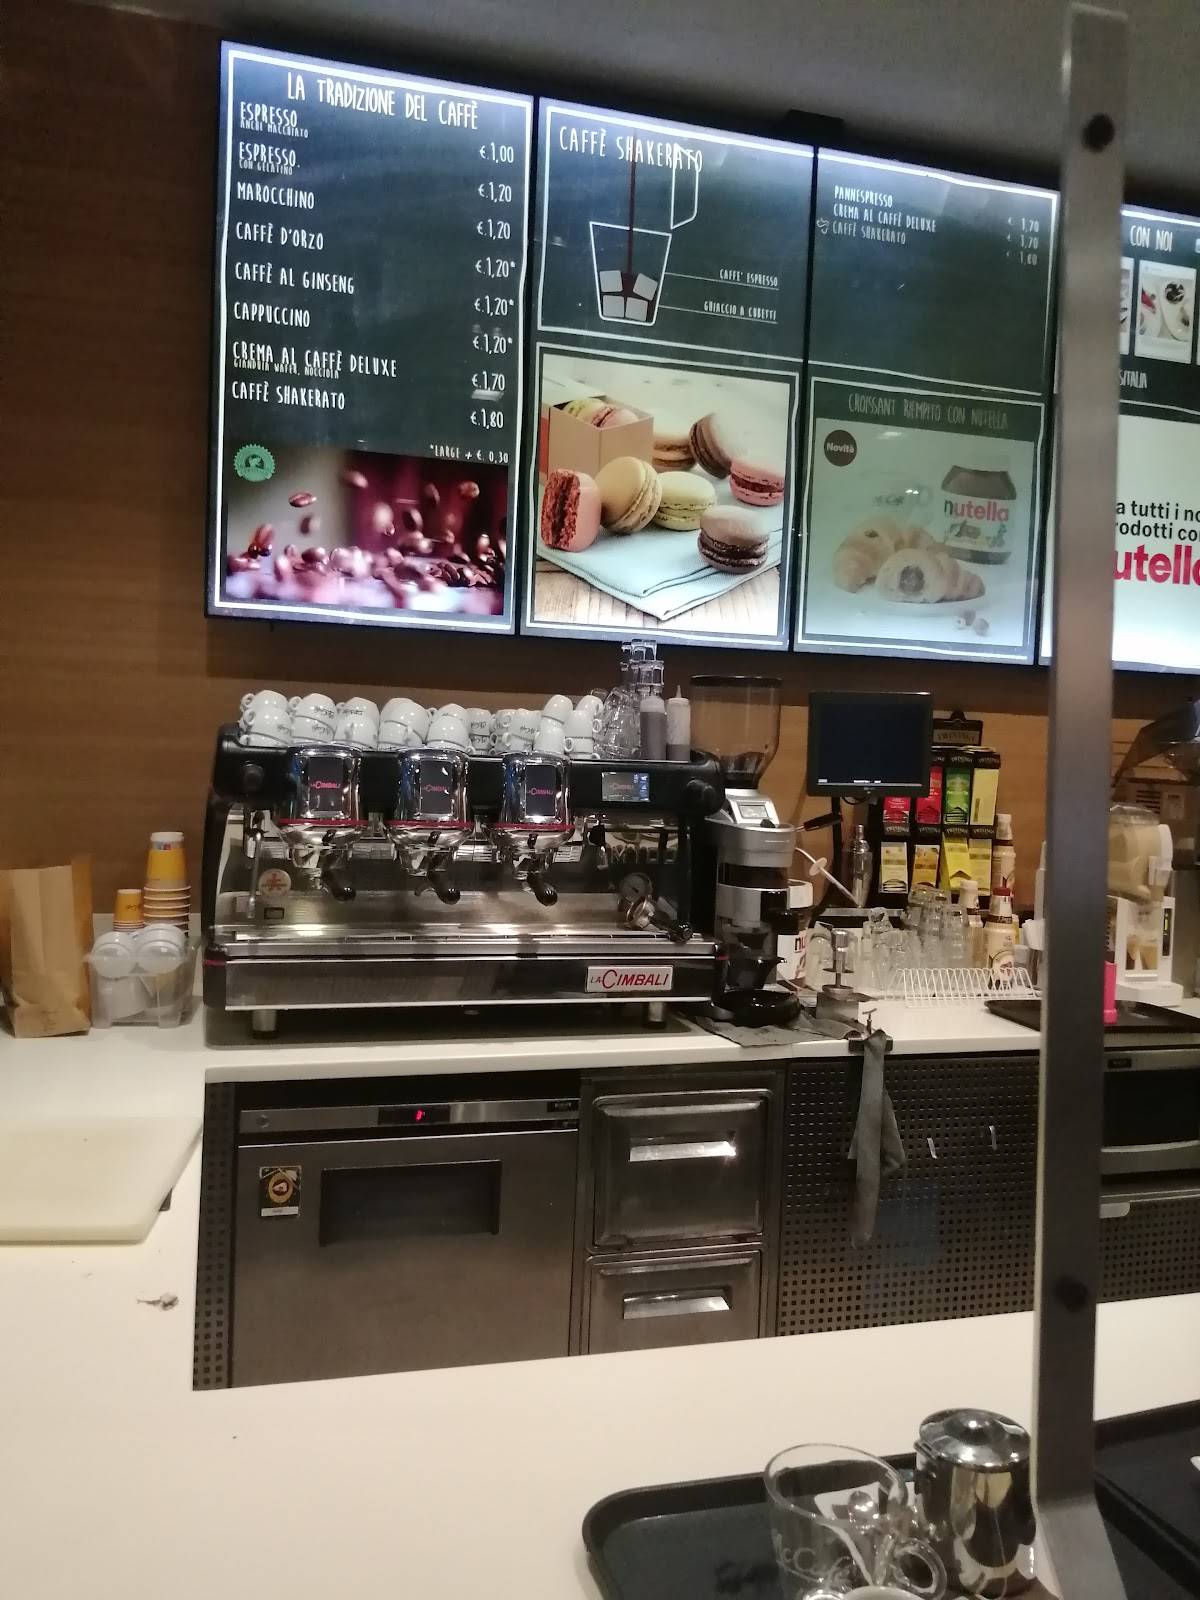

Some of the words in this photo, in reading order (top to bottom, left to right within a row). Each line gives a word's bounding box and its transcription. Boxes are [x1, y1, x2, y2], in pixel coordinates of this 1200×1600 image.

[288, 72, 305, 101] LA
[317, 78, 395, 116] TRADIZIONE
[405, 93, 428, 121] DEL
[439, 101, 478, 130] CAFFÈ
[241, 102, 298, 128] ESPRESSO
[239, 142, 296, 167] ESPRESSO
[559, 126, 607, 157] CAFFÈ
[616, 135, 703, 173] SHAKERATO
[239, 159, 254, 170] CON
[257, 161, 293, 175] GELATINO
[237, 182, 315, 210] MAROCCHINO
[834, 185, 893, 208] PANNESPRESSO
[832, 220, 857, 237] CAFFÈ
[833, 203, 859, 220] CREMA
[863, 208, 873, 223] AL
[878, 211, 902, 227] CAFFÈ
[906, 214, 936, 233] DELUXE
[236, 222, 274, 244] CAFFÈ
[280, 227, 324, 250] D'ORZO
[1130, 225, 1150, 249] CON
[1155, 229, 1173, 253] NOI
[235, 262, 272, 284] CAFFÈ
[280, 267, 295, 287] AL
[302, 271, 355, 295] GINSENG
[746, 272, 778, 287] ESPRESSO
[234, 302, 311, 328] CAPPUCCINO
[739, 305, 745, 316] A
[232, 341, 273, 363] CREMA
[281, 347, 297, 366] AL
[304, 350, 343, 371] CAFFÈ
[350, 354, 397, 378] DELUXE
[232, 381, 269, 403] CAFFÈ
[276, 385, 345, 410] SHAKERATO
[848, 392, 896, 416] CROISSANT
[947, 406, 966, 425] CON
[944, 499, 1009, 522] nutella
[1130, 500, 1170, 520] tutti
[1175, 502, 1179, 520] i
[590, 976, 601, 984] LA
[602, 969, 669, 989] CIMBALI
